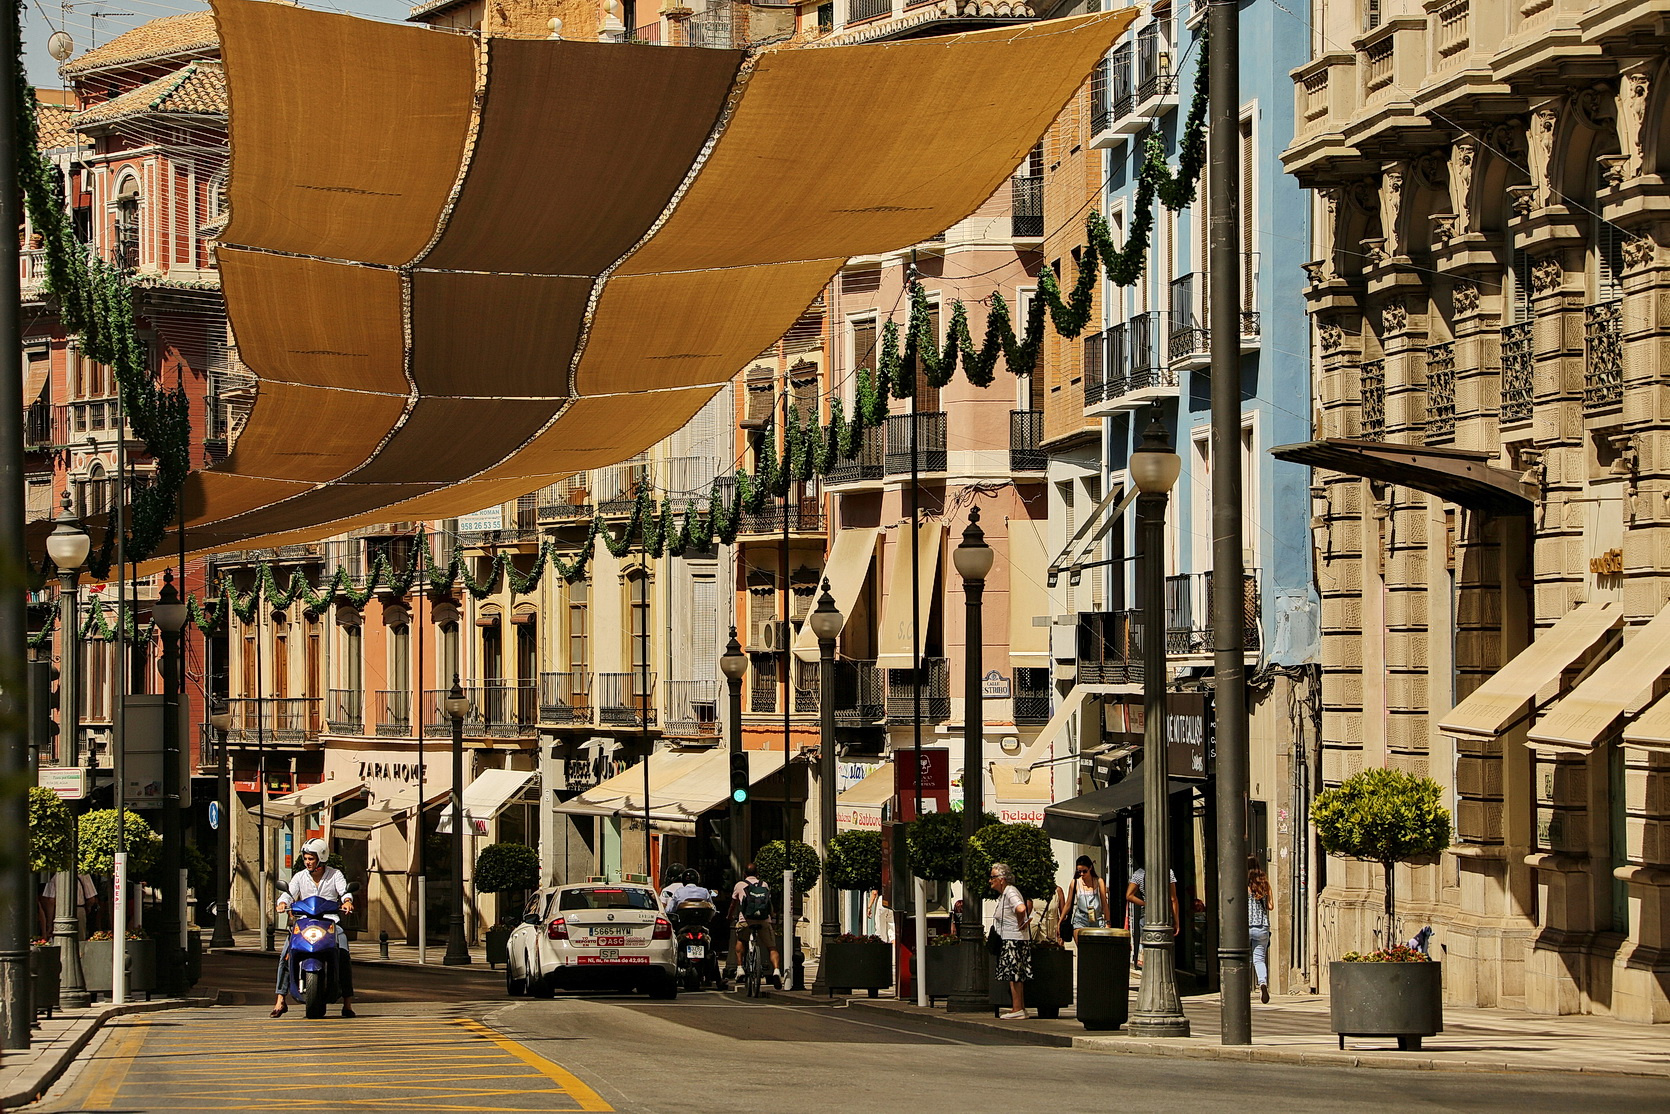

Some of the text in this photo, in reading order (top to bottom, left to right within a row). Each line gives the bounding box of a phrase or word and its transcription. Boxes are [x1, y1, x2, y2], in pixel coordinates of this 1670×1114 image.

[460, 520, 501, 531] 958 26 53 55
[1456, 702, 1508, 720] CORTEFIEL
[1547, 711, 1605, 730] CORTEFIEL
[358, 761, 428, 784] ZARA HOME
[594, 927, 614, 936] 5665
[601, 950, 617, 958] SP
